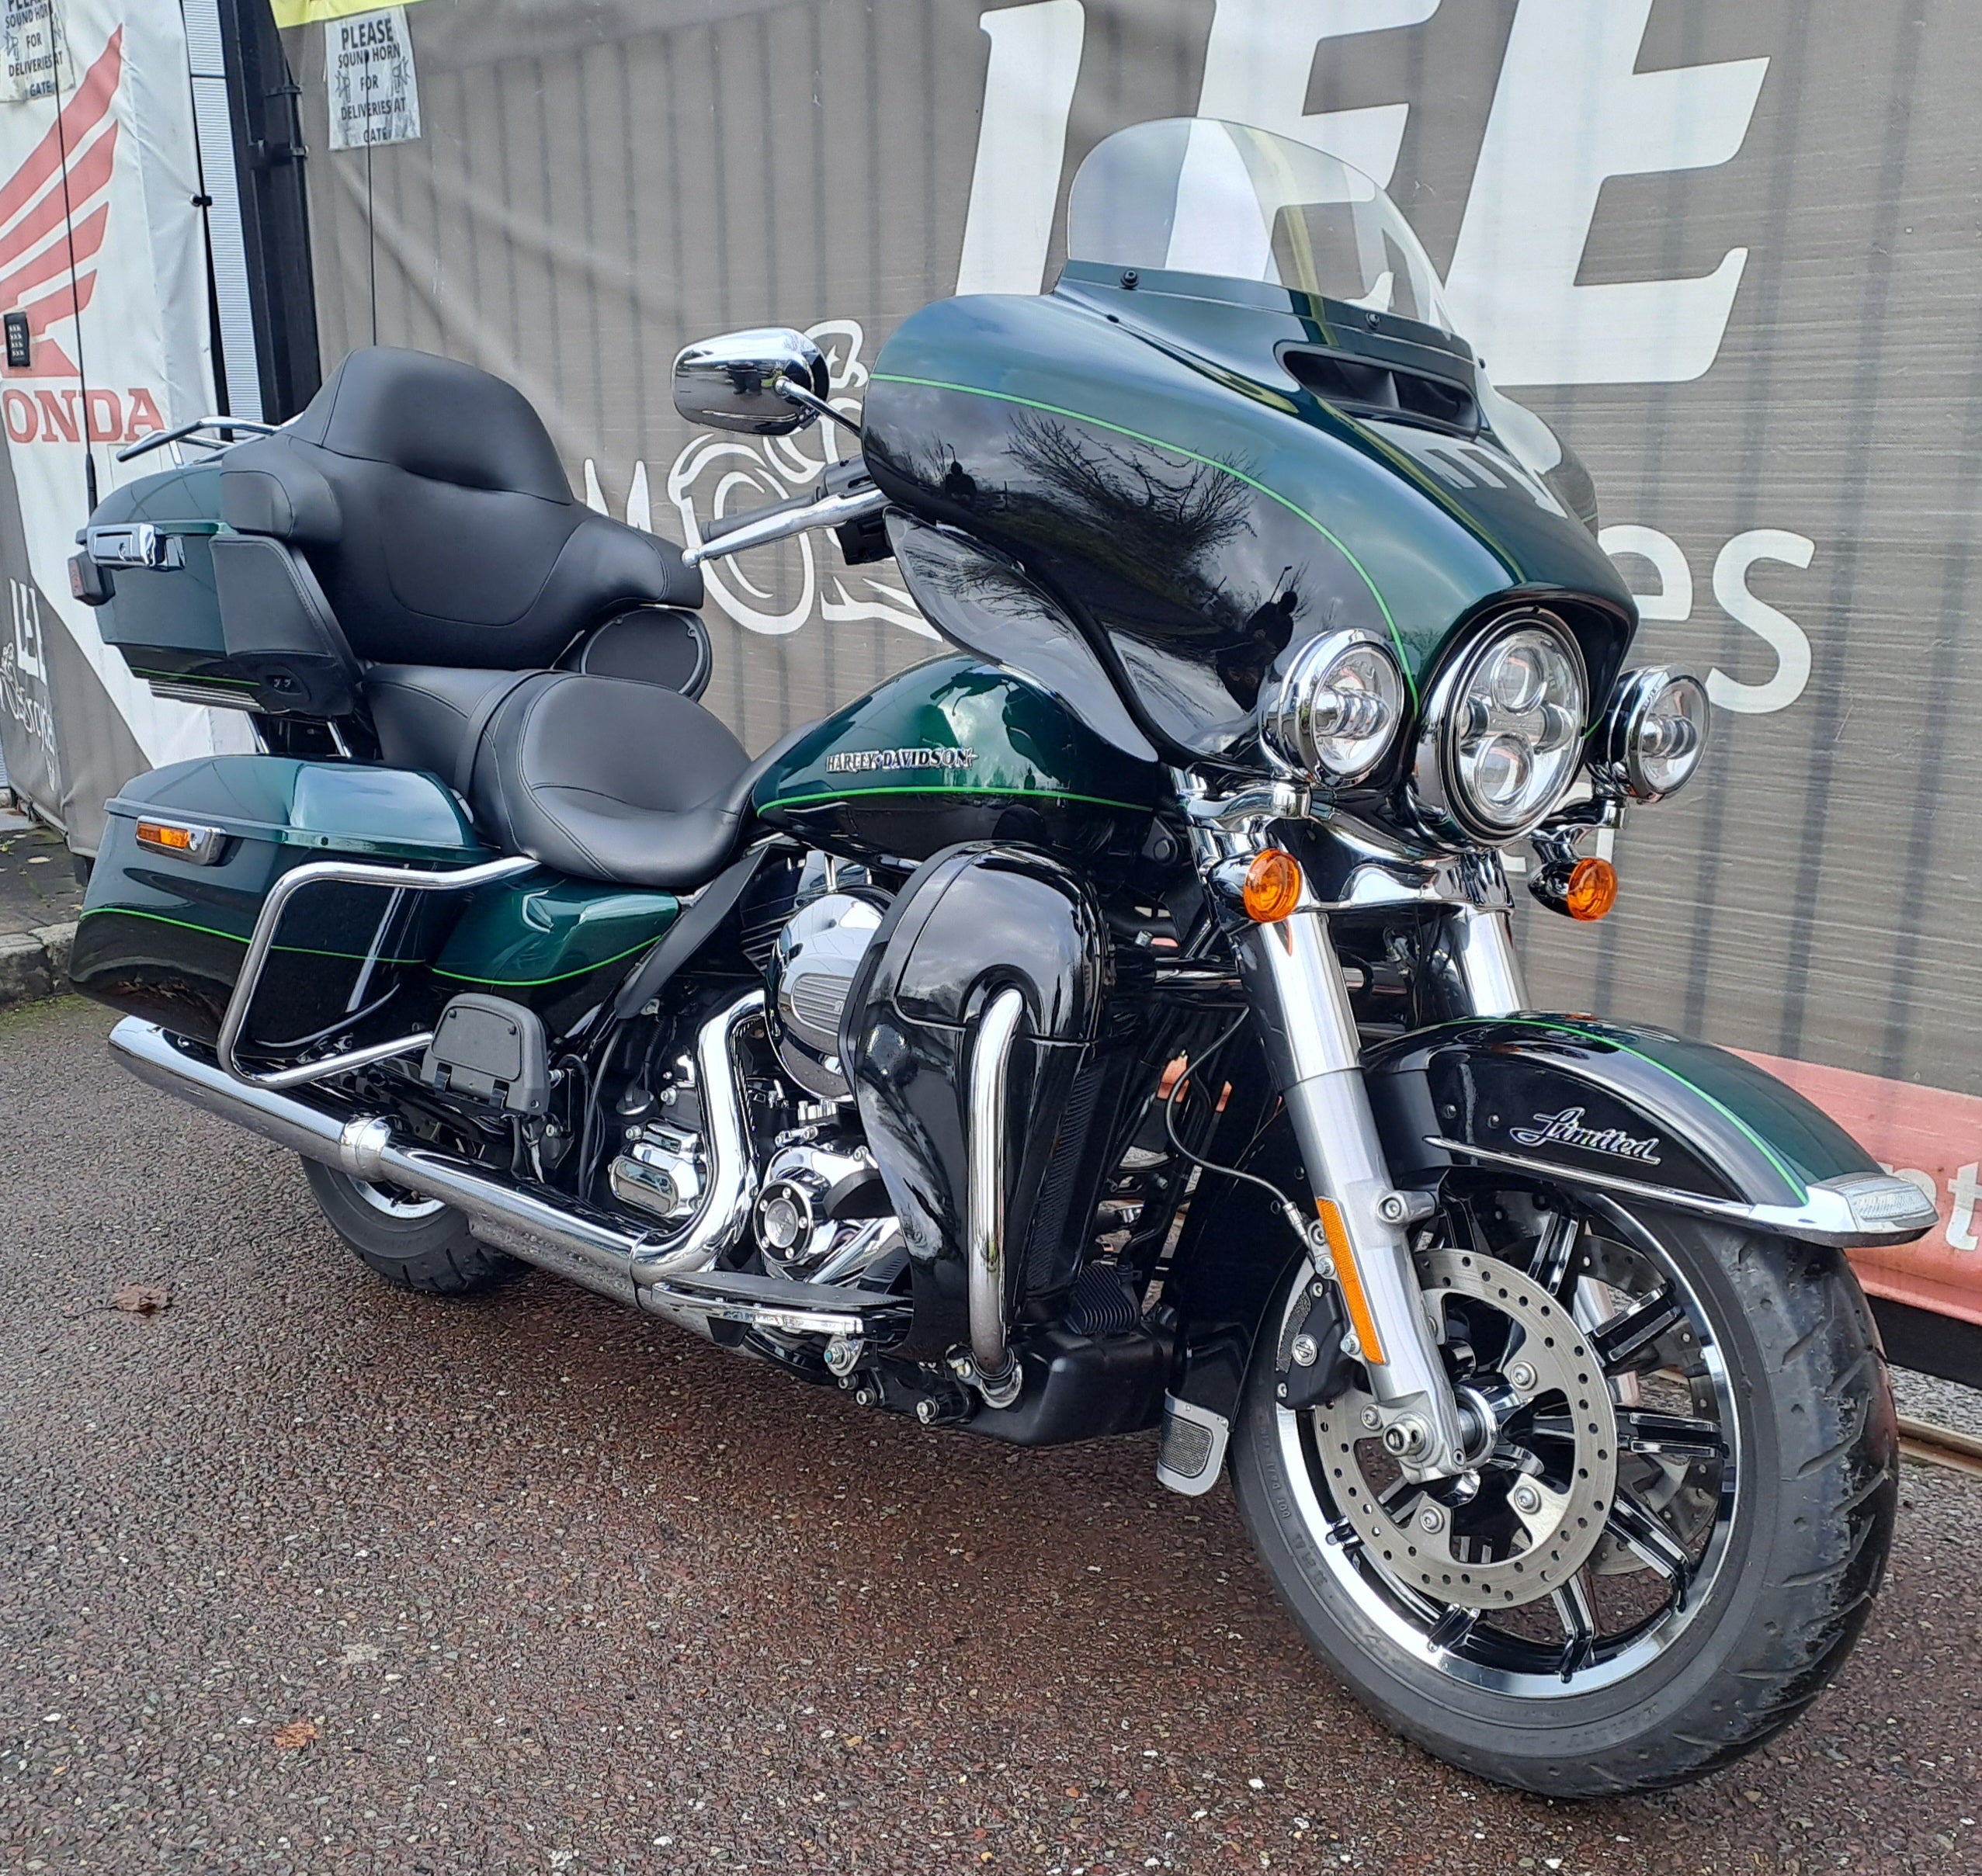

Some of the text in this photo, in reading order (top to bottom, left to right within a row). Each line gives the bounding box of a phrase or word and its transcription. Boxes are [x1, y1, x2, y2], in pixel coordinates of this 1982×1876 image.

[5, 9, 33, 29] SOUND
[34, 3, 52, 20] HOR
[26, 32, 42, 48] FOR
[342, 18, 394, 50] PLEASE
[373, 43, 401, 62] HORN
[9, 54, 52, 77] DELIVERIES
[30, 81, 51, 96] GATE
[360, 75, 379, 92] FOR
[341, 97, 406, 120] DELIVERIES AT
[1510, 1107, 1661, 1165] Limited
